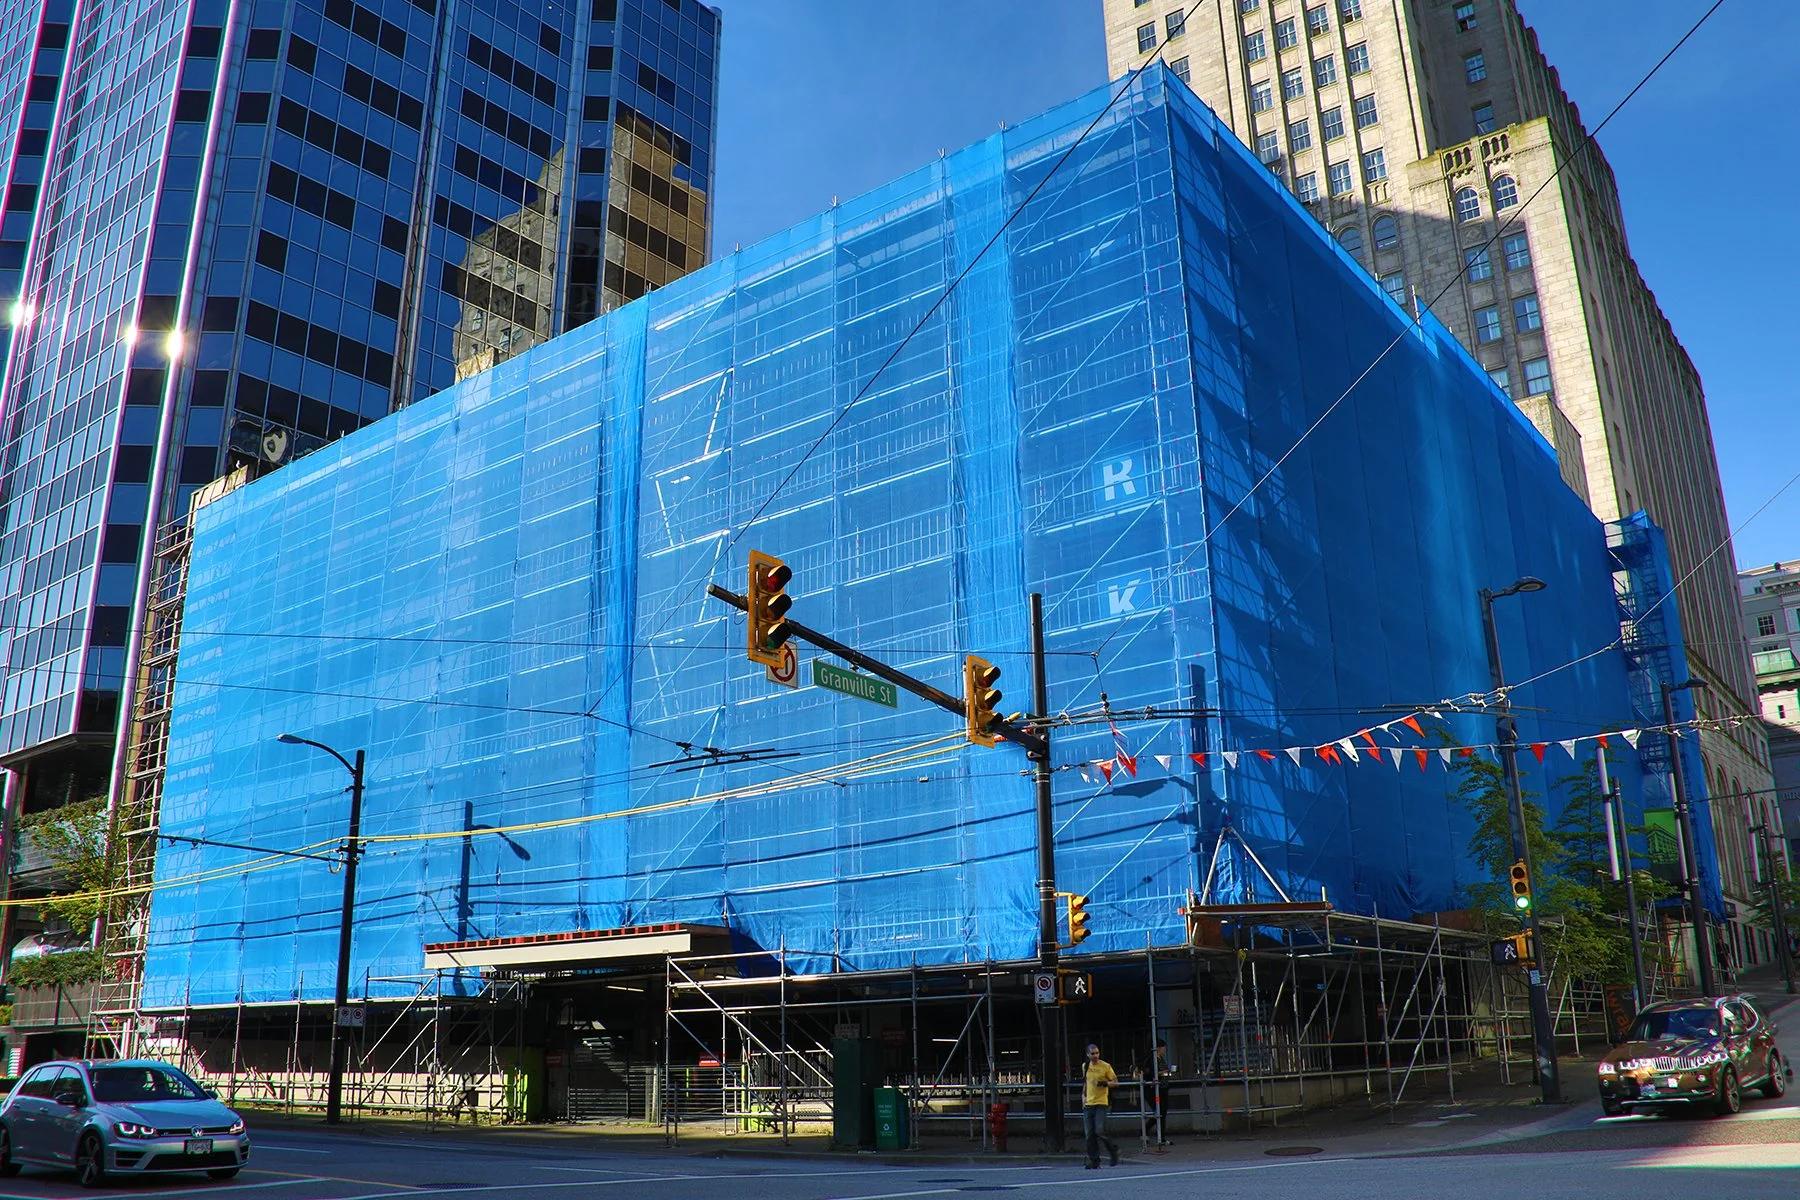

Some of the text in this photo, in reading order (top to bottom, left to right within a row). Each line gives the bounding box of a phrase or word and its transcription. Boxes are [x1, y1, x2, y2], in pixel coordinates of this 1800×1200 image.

[1102, 457, 1137, 502] R
[1107, 578, 1141, 616] K
[820, 667, 892, 704] Granville St
